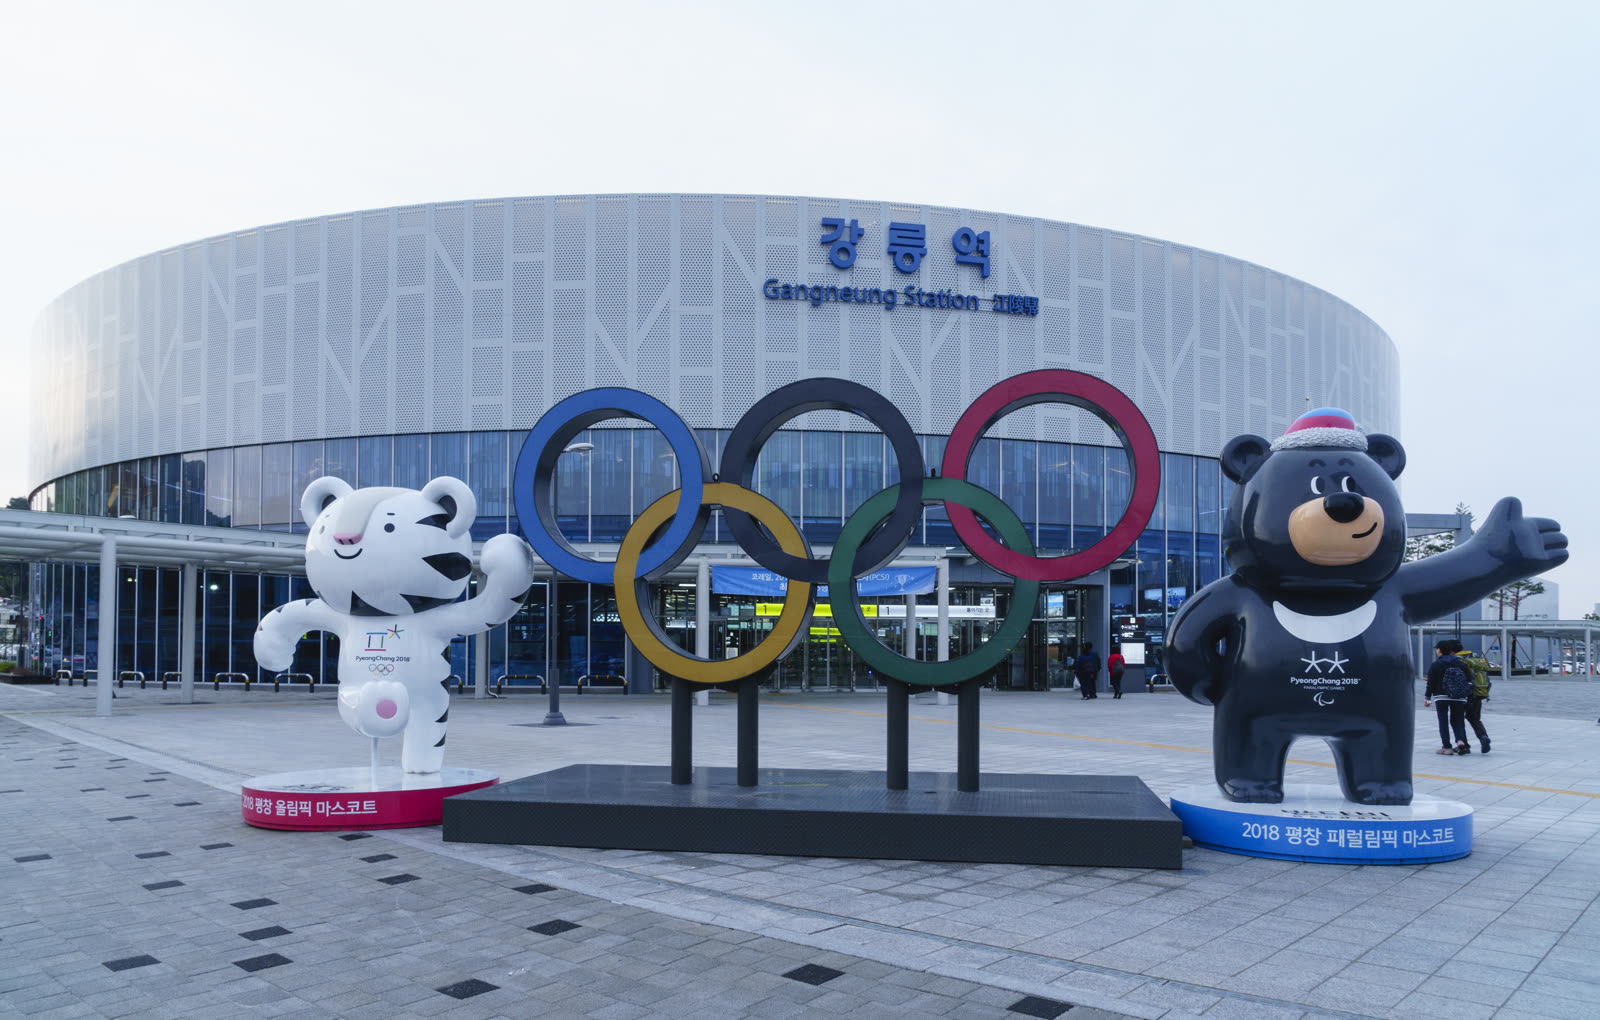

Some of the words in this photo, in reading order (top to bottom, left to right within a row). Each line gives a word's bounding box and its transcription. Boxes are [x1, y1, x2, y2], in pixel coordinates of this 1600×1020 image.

[763, 278, 898, 310] Gangneung
[904, 284, 980, 311] Station
[762, 604, 767, 615] 1
[886, 606, 890, 616] 1
[1290, 676, 1341, 685] PyeongChang
[255, 797, 273, 815] 평창
[274, 799, 312, 817] 올림픽
[316, 800, 378, 817] 마스코트
[1242, 822, 1280, 841] 2018
[1285, 825, 1322, 847] 평창
[1327, 828, 1398, 849] 패럴림픽
[1403, 827, 1455, 848] 마스코트
